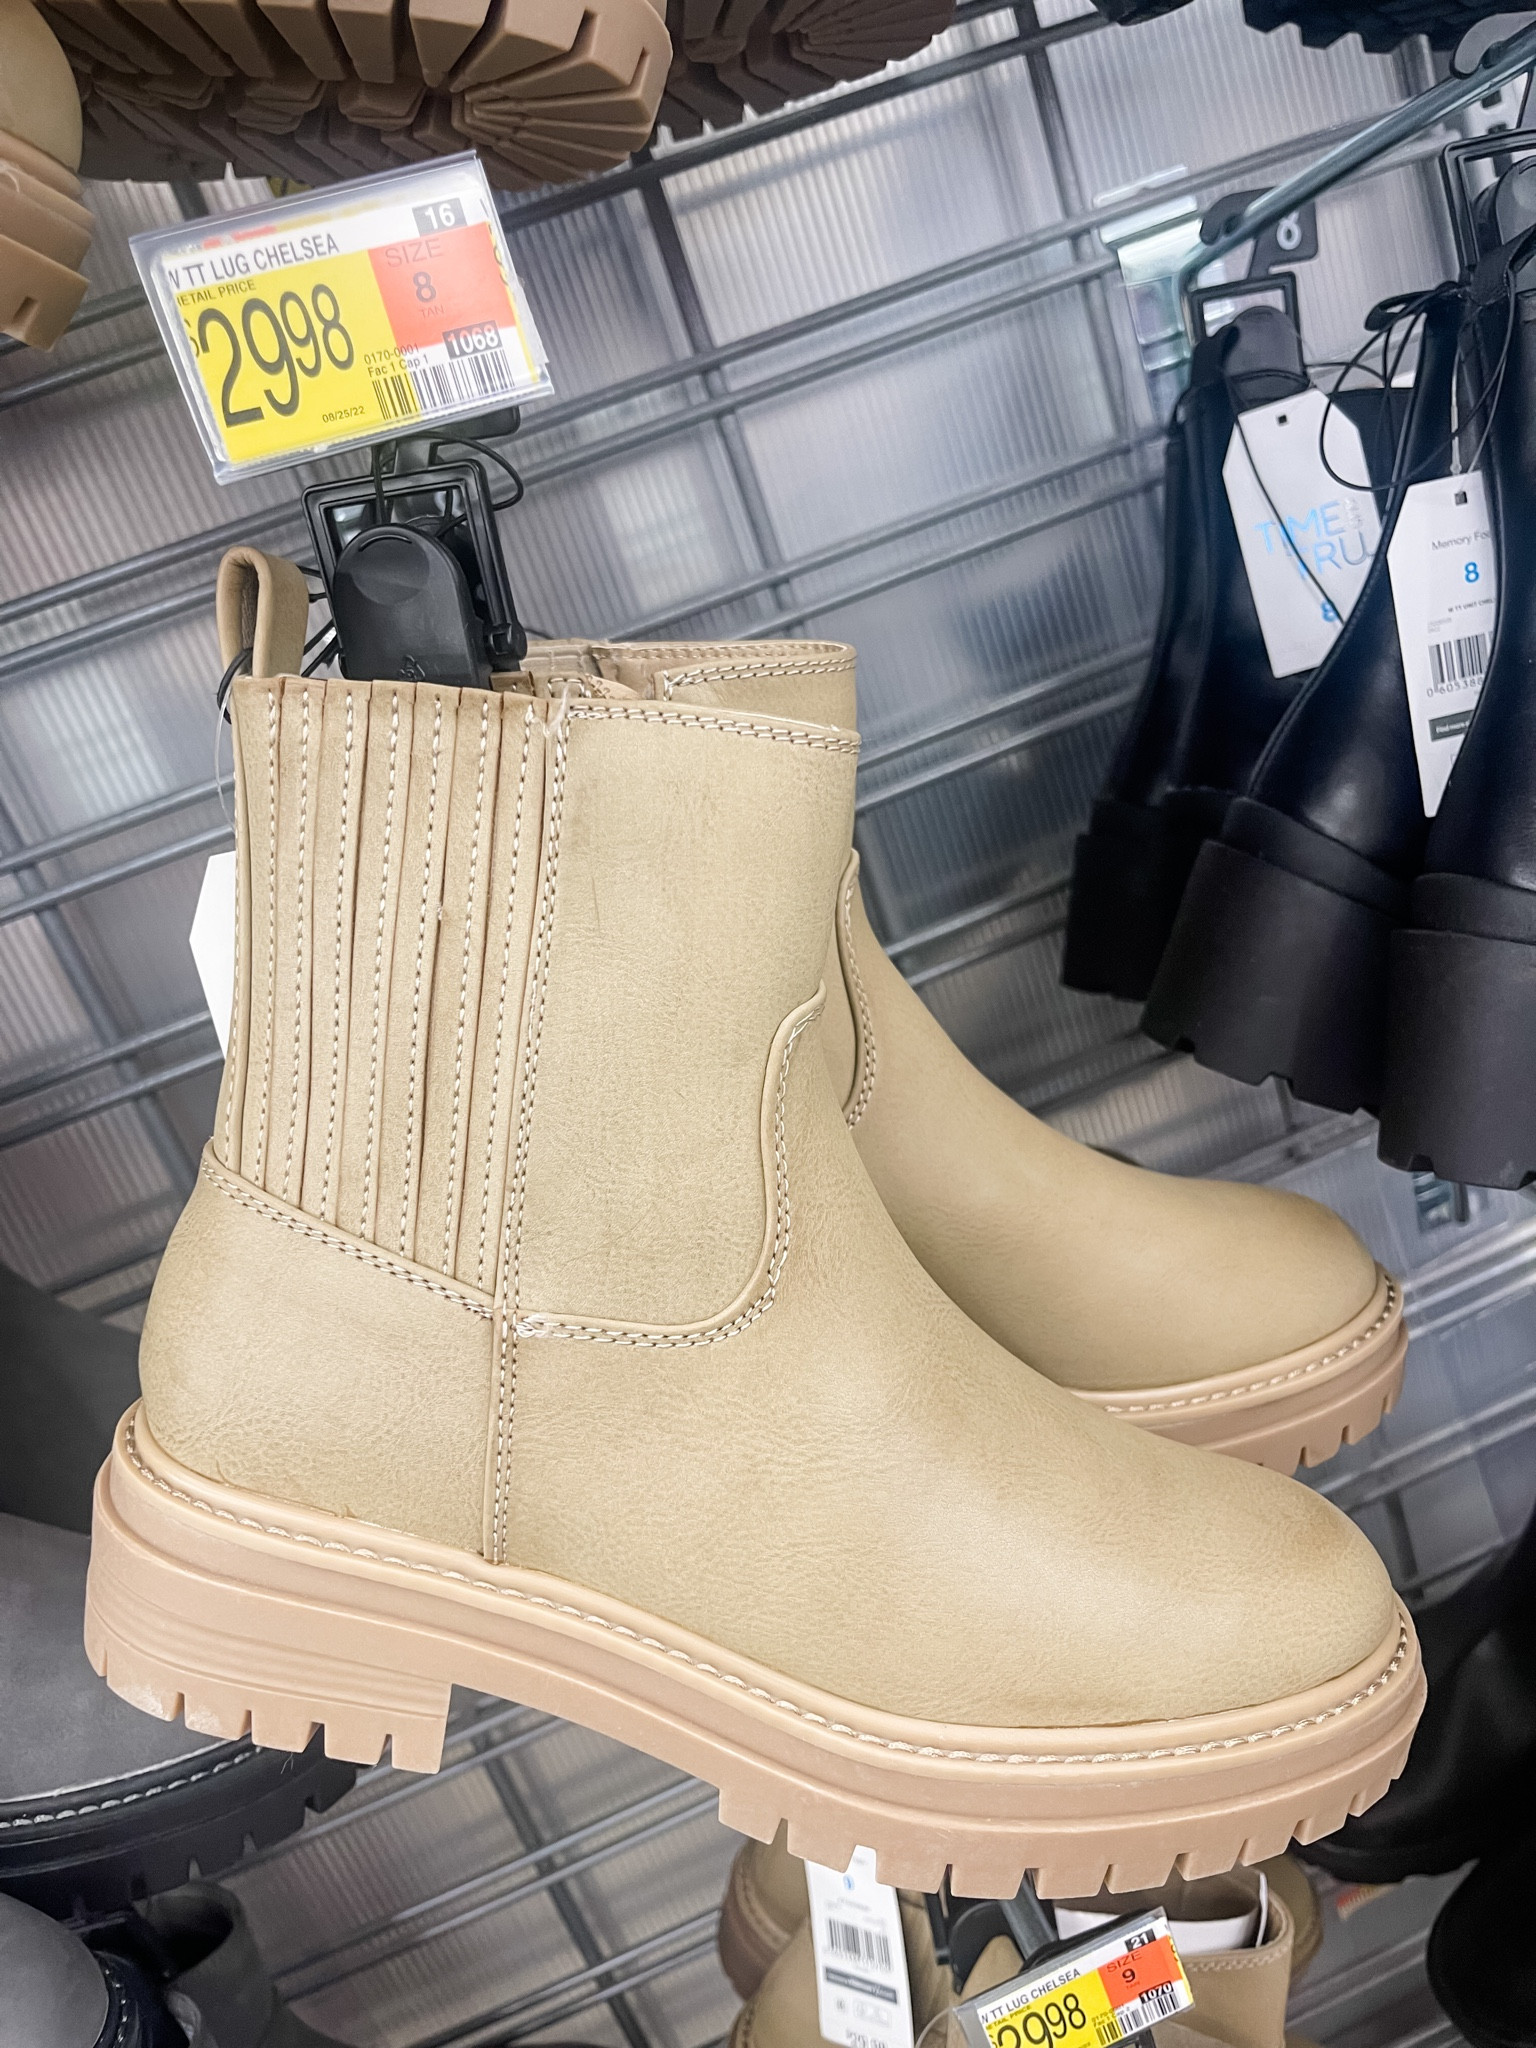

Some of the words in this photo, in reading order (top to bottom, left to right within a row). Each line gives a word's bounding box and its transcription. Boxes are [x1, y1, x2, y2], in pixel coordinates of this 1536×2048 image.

[425, 203, 456, 229] 16
[183, 264, 206, 286] TT
[210, 253, 250, 281] LUG
[253, 233, 340, 270] CHELSEA
[385, 238, 443, 268] SIZE
[218, 279, 256, 298] PRICE
[413, 271, 436, 303] 8
[419, 305, 445, 319] TAN
[444, 324, 499, 356] 1068
[364, 344, 420, 365] 0170-0001
[368, 365, 388, 378] Fac
[390, 363, 396, 372] 1
[399, 357, 421, 370] Cap
[423, 354, 429, 365] 1
[322, 406, 365, 423] 08/25/22
[1431, 535, 1472, 551] Memory
[1464, 561, 1479, 583] 8
[1130, 1933, 1150, 1950] 21
[1106, 1950, 1142, 1973] SIZE
[1122, 1968, 1136, 1983] 9
[990, 2006, 1004, 2020] TT
[1005, 1994, 1029, 2012] LUG
[1030, 1968, 1081, 1999] CHELSEA
[1141, 1983, 1172, 2003] 1070
